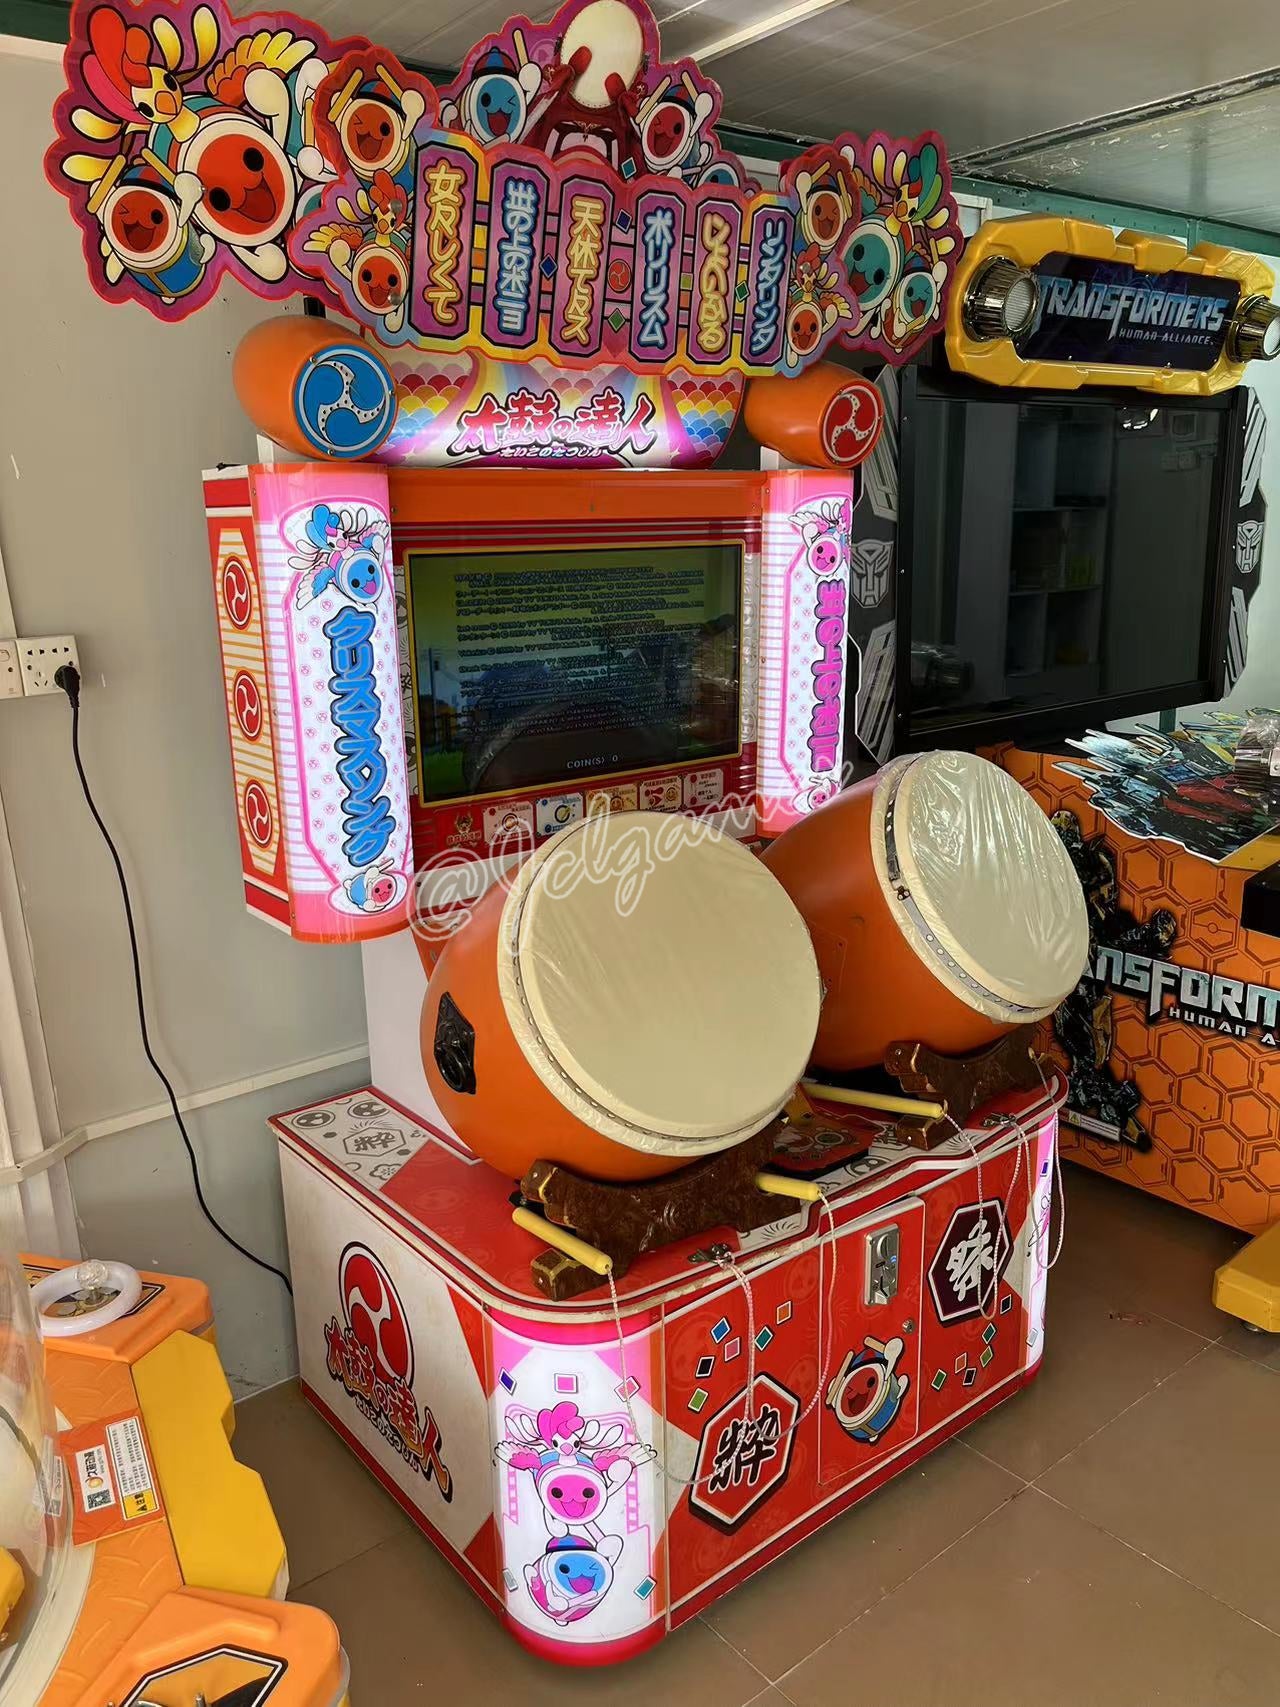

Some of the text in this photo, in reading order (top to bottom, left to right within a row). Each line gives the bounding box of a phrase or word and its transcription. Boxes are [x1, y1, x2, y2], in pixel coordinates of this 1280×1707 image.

[1119, 328, 1211, 345] HUMAN ALLIANCE
[449, 388, 655, 456] 太鼓の達人
[324, 607, 395, 866] クリスマスソング
[566, 756, 605, 769] COIN(S)
[1169, 1007, 1247, 1037] HUMAN
[324, 1316, 453, 1504] 太鼓の達人
